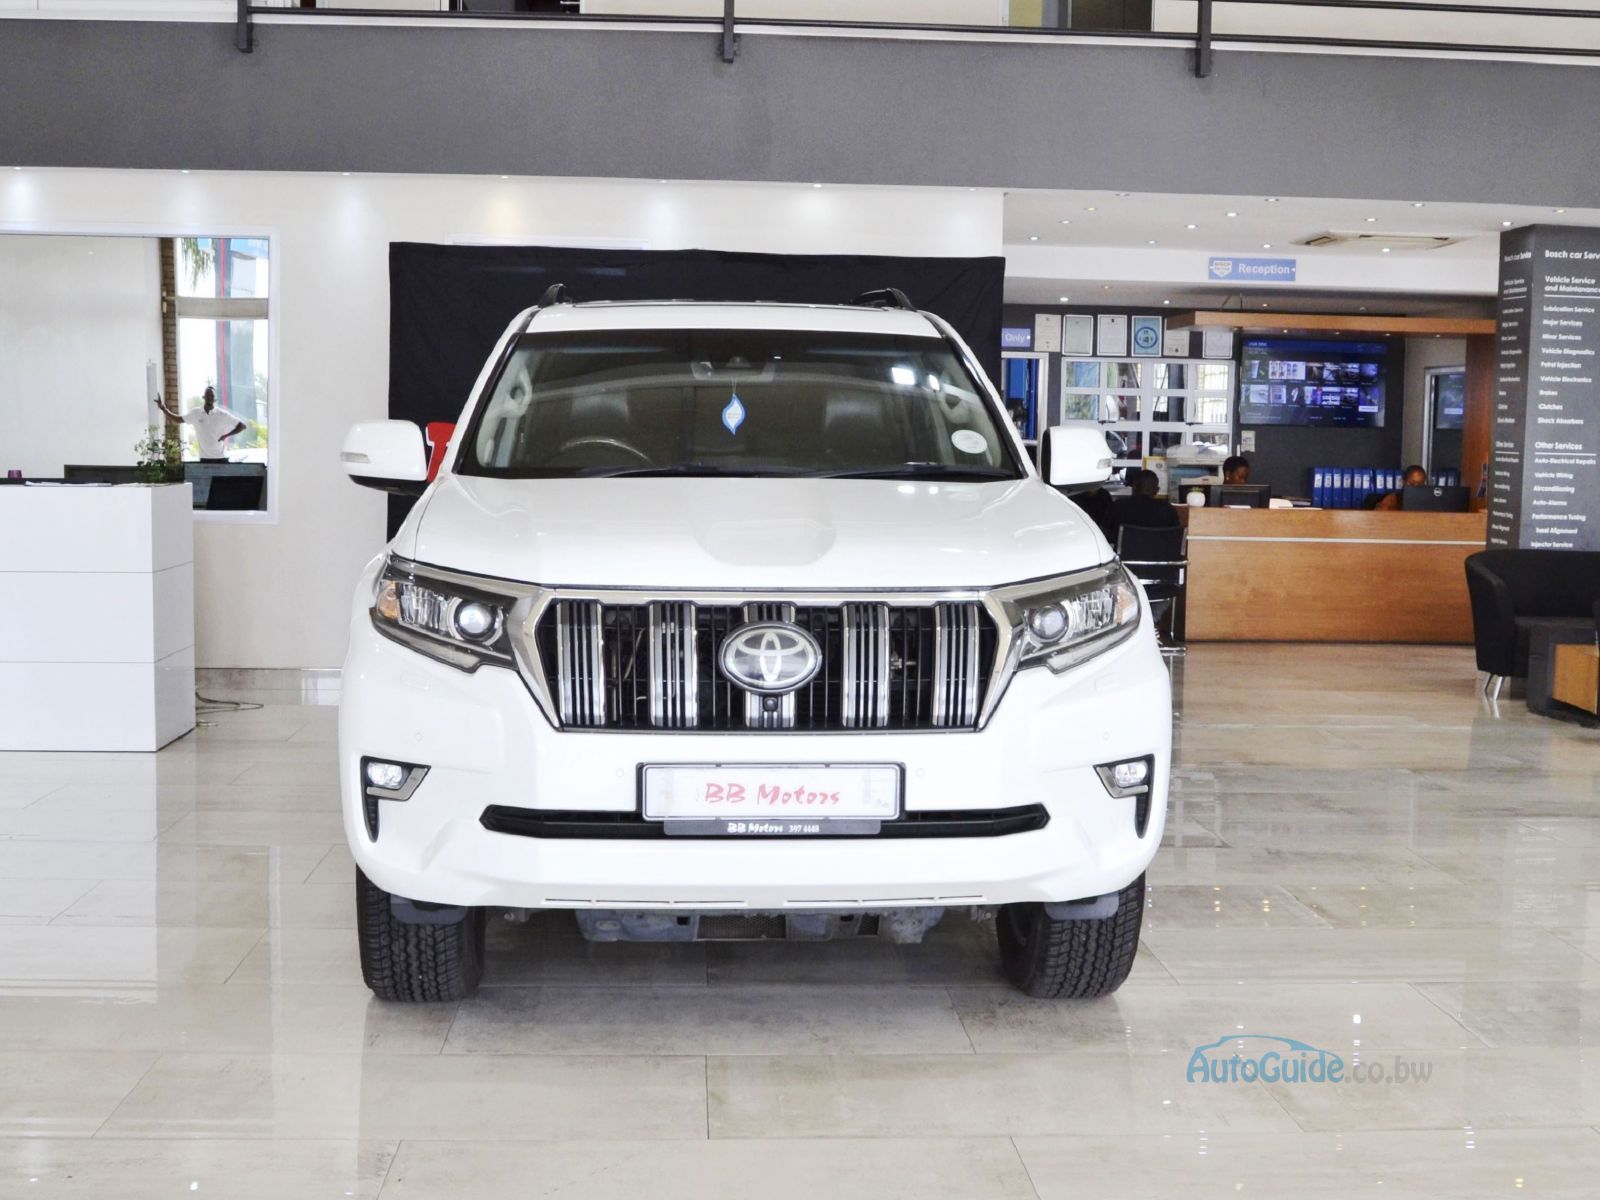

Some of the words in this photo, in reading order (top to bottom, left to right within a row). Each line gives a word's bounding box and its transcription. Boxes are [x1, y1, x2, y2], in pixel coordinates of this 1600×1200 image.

[1545, 250, 1568, 258] Bosch
[1238, 264, 1290, 276] Reception
[1571, 276, 1595, 284] Service
[1005, 333, 1025, 344] Only
[1534, 441, 1554, 449] Other
[1554, 442, 1582, 450] Services
[705, 783, 746, 804] BB
[757, 783, 840, 805] Motors
[727, 822, 746, 833] BB
[747, 822, 783, 833] Motors
